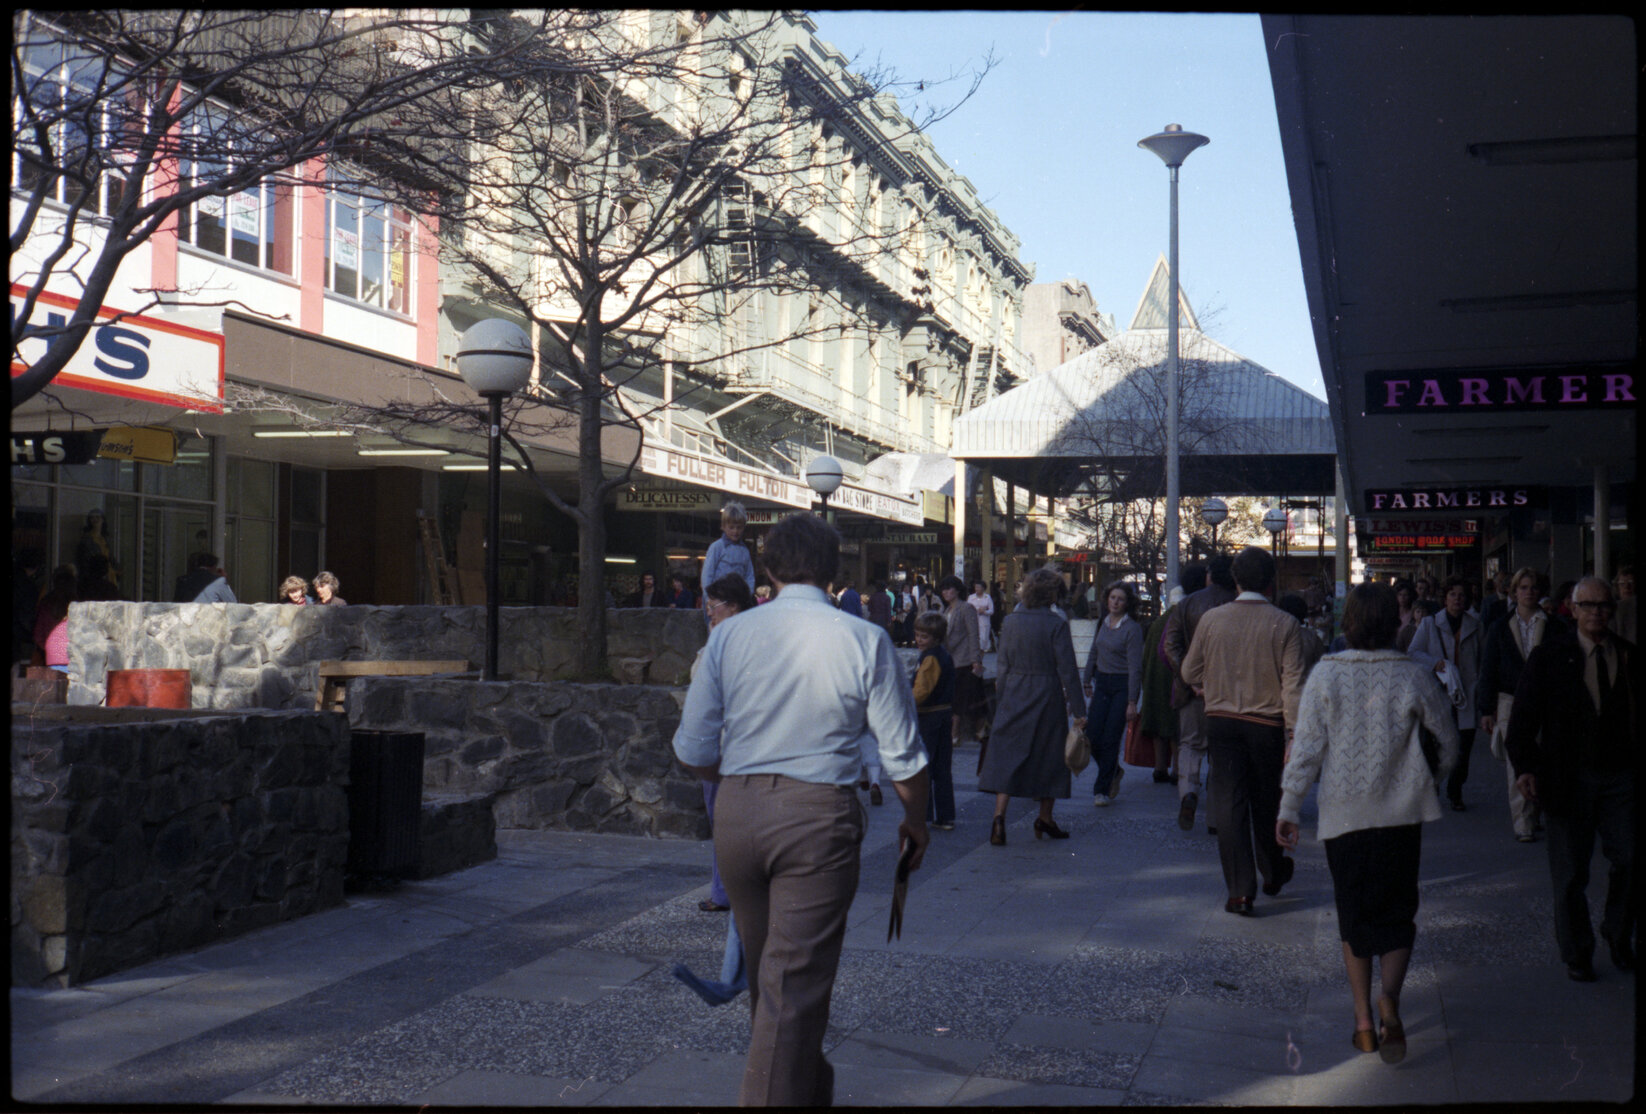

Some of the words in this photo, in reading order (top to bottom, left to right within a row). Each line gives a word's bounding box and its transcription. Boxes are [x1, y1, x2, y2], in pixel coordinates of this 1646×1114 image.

[1384, 374, 1637, 407] FARMER
[11, 436, 66, 463] HS
[668, 453, 726, 486] FULLER
[739, 471, 789, 501] FULTON
[626, 492, 711, 504] DELICATESSEN
[856, 491, 873, 511] STORE
[1373, 490, 1528, 509] FARMERS
[746, 512, 771, 522] ONDON
[1372, 519, 1461, 532] LEWIS'S
[1375, 535, 1416, 547] LONDON
[1417, 535, 1445, 548] BOOK
[1448, 535, 1475, 548] SHOP
